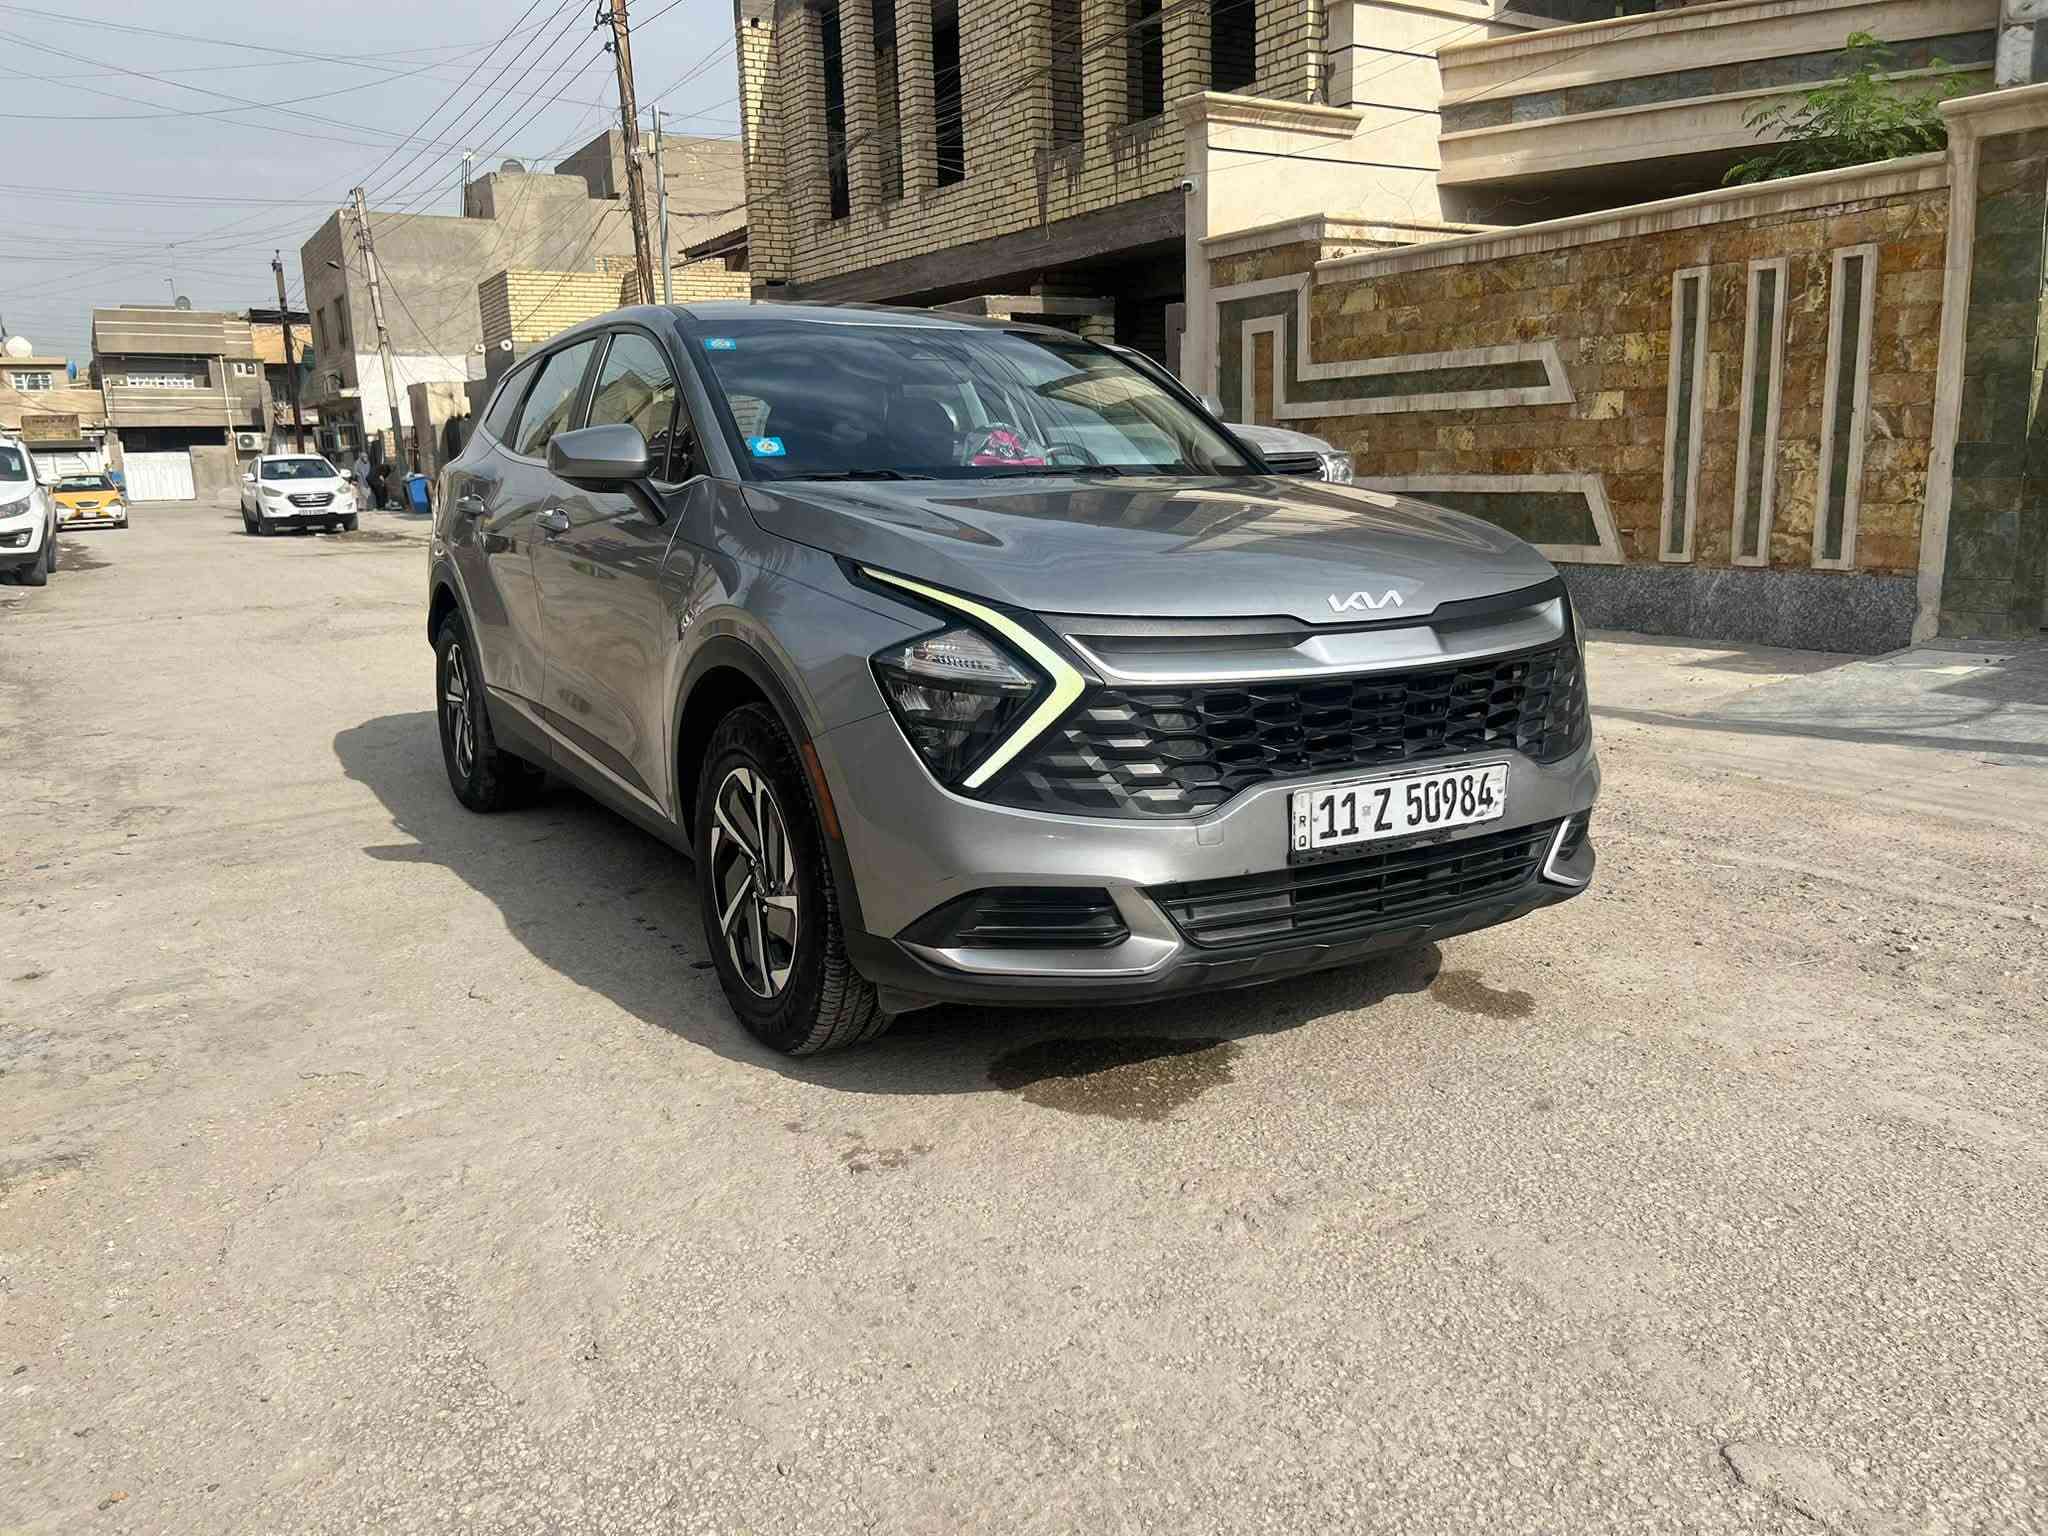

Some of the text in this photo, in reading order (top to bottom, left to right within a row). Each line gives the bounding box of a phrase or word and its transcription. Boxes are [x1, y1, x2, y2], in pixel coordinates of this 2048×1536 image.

[1328, 590, 1403, 612] KIA
[1320, 772, 1494, 840] 11 Z 50984
